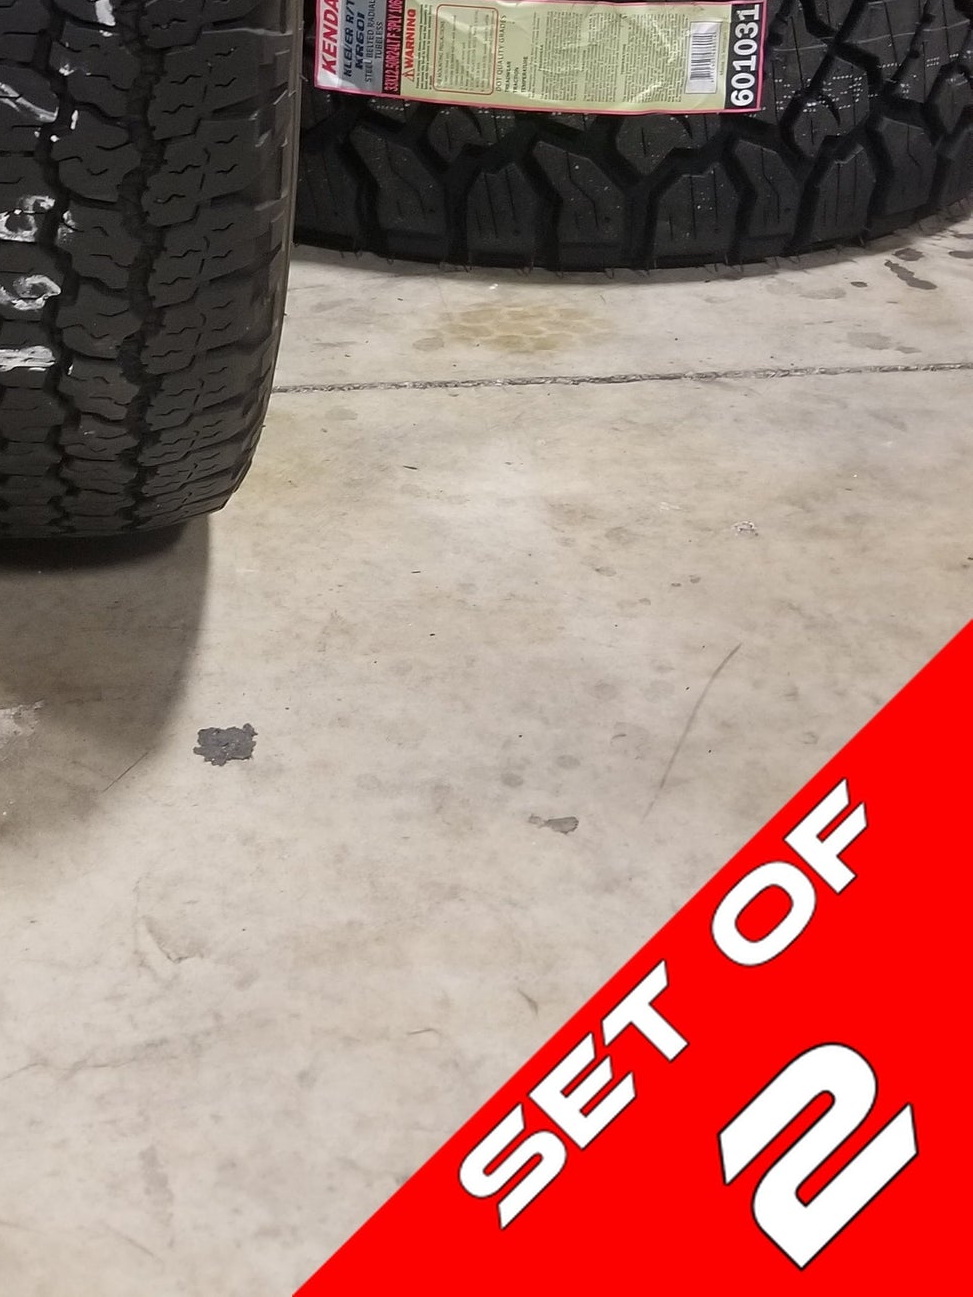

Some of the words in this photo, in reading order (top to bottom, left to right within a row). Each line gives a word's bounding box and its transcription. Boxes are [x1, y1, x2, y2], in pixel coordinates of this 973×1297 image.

[368, 0, 376, 28] RADIAL
[499, 15, 507, 43] GRADES
[344, 28, 354, 77] KLEVER
[367, 29, 375, 58] BELTED
[375, 21, 383, 59] TUBELESS
[404, 8, 416, 69] WARNING
[730, 4, 760, 107] 601031
[365, 59, 373, 82] STEEL
[497, 44, 505, 76] QUALITY
[521, 56, 529, 93] TEMPERATURE
